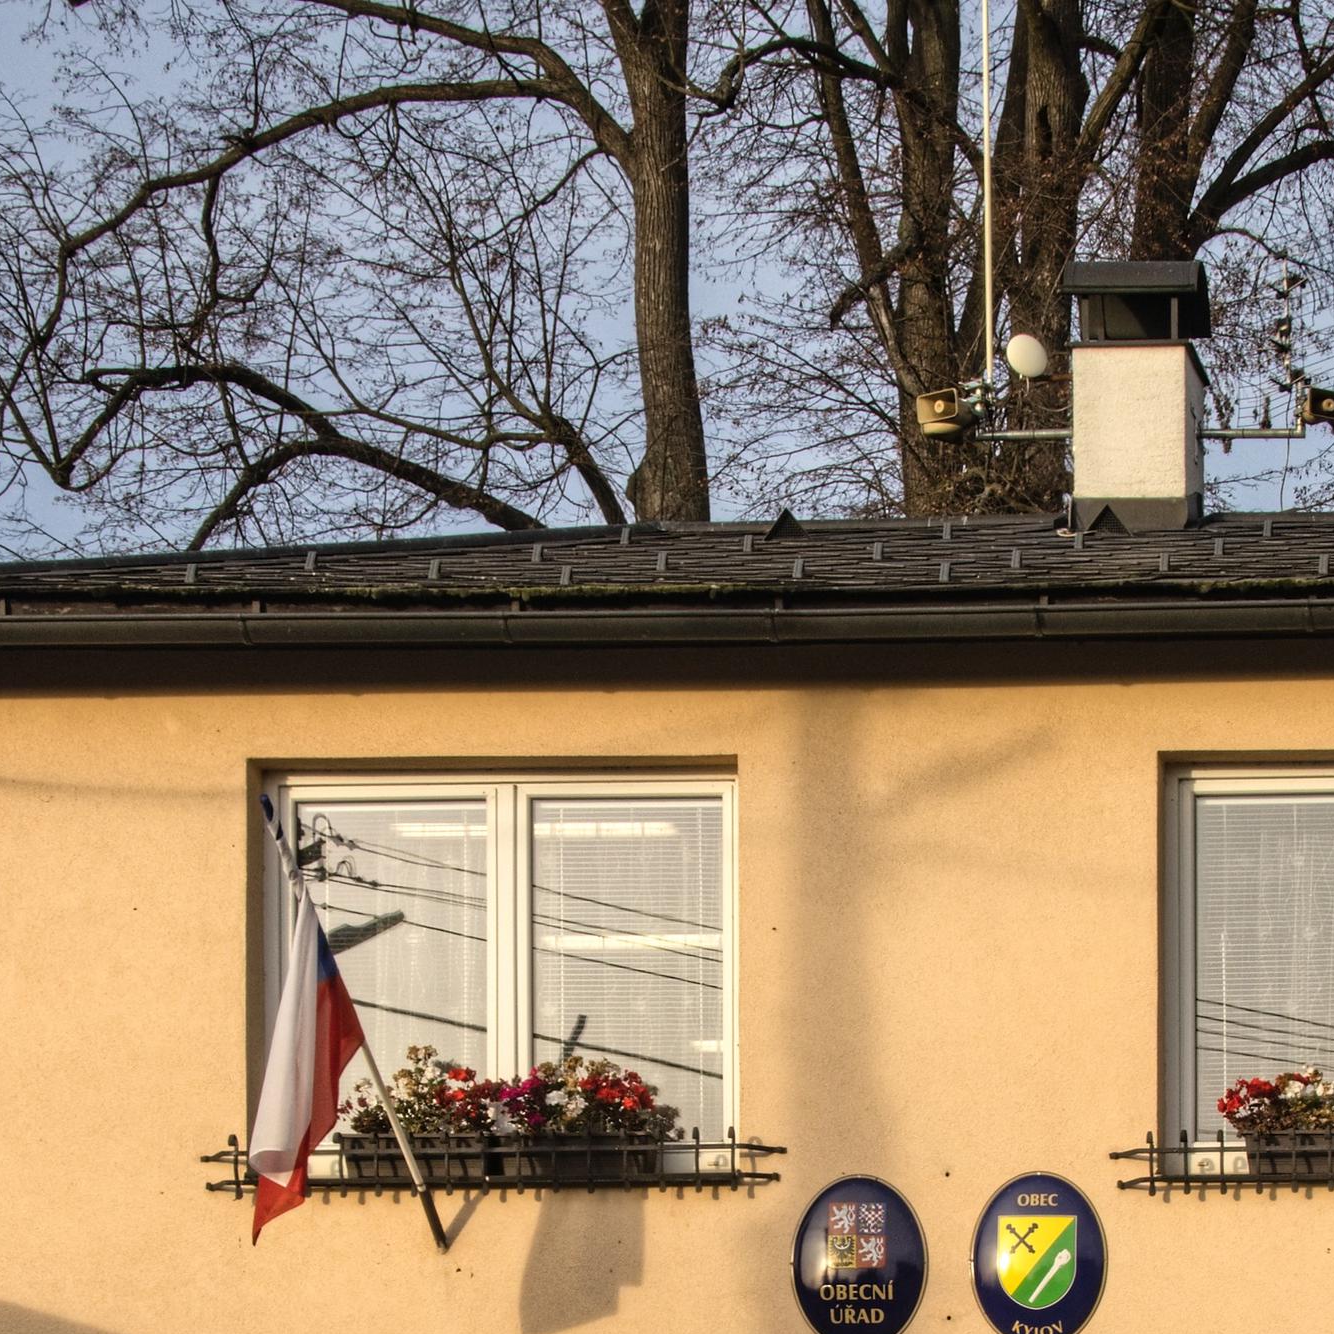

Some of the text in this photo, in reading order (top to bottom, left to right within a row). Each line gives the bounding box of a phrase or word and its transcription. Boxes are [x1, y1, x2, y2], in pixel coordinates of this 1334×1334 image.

[1017, 1193, 1058, 1207] OBEC
[819, 1280, 894, 1301] OBECNÍ
[830, 1304, 885, 1324] ÚŘAD
